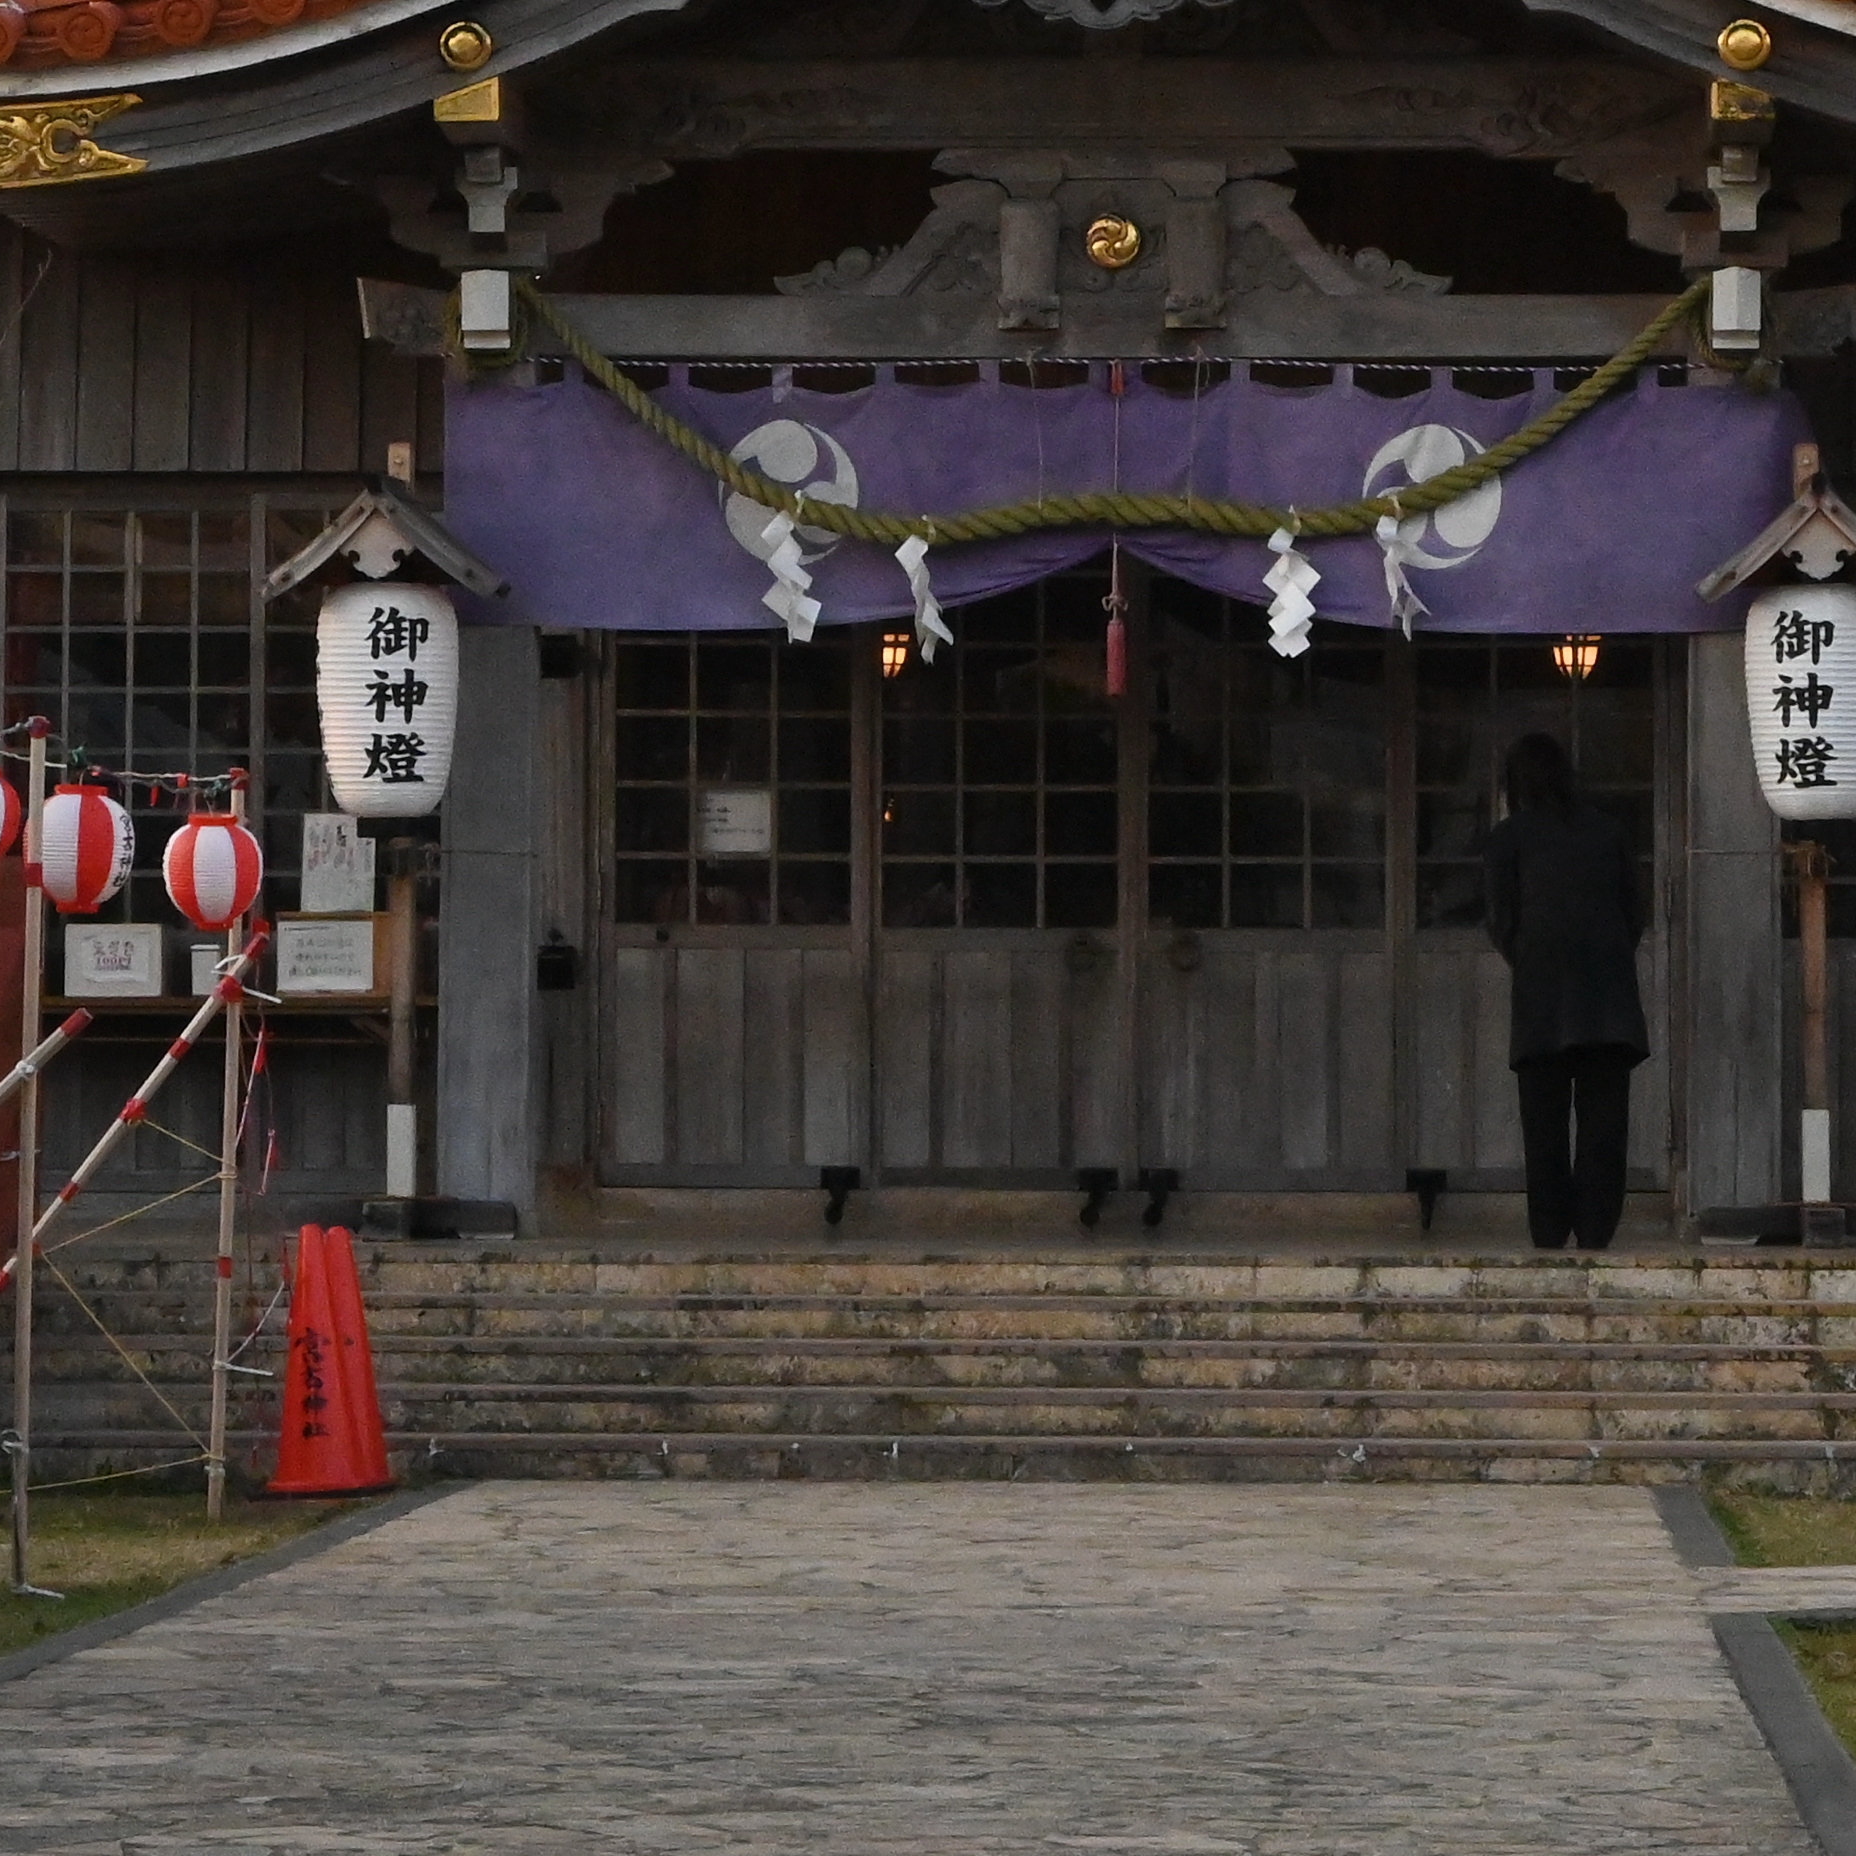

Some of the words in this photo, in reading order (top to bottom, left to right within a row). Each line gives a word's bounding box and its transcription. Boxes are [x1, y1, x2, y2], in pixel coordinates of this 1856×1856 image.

[363, 606, 430, 784] 御神燈
[1770, 610, 1838, 789] 御神燈
